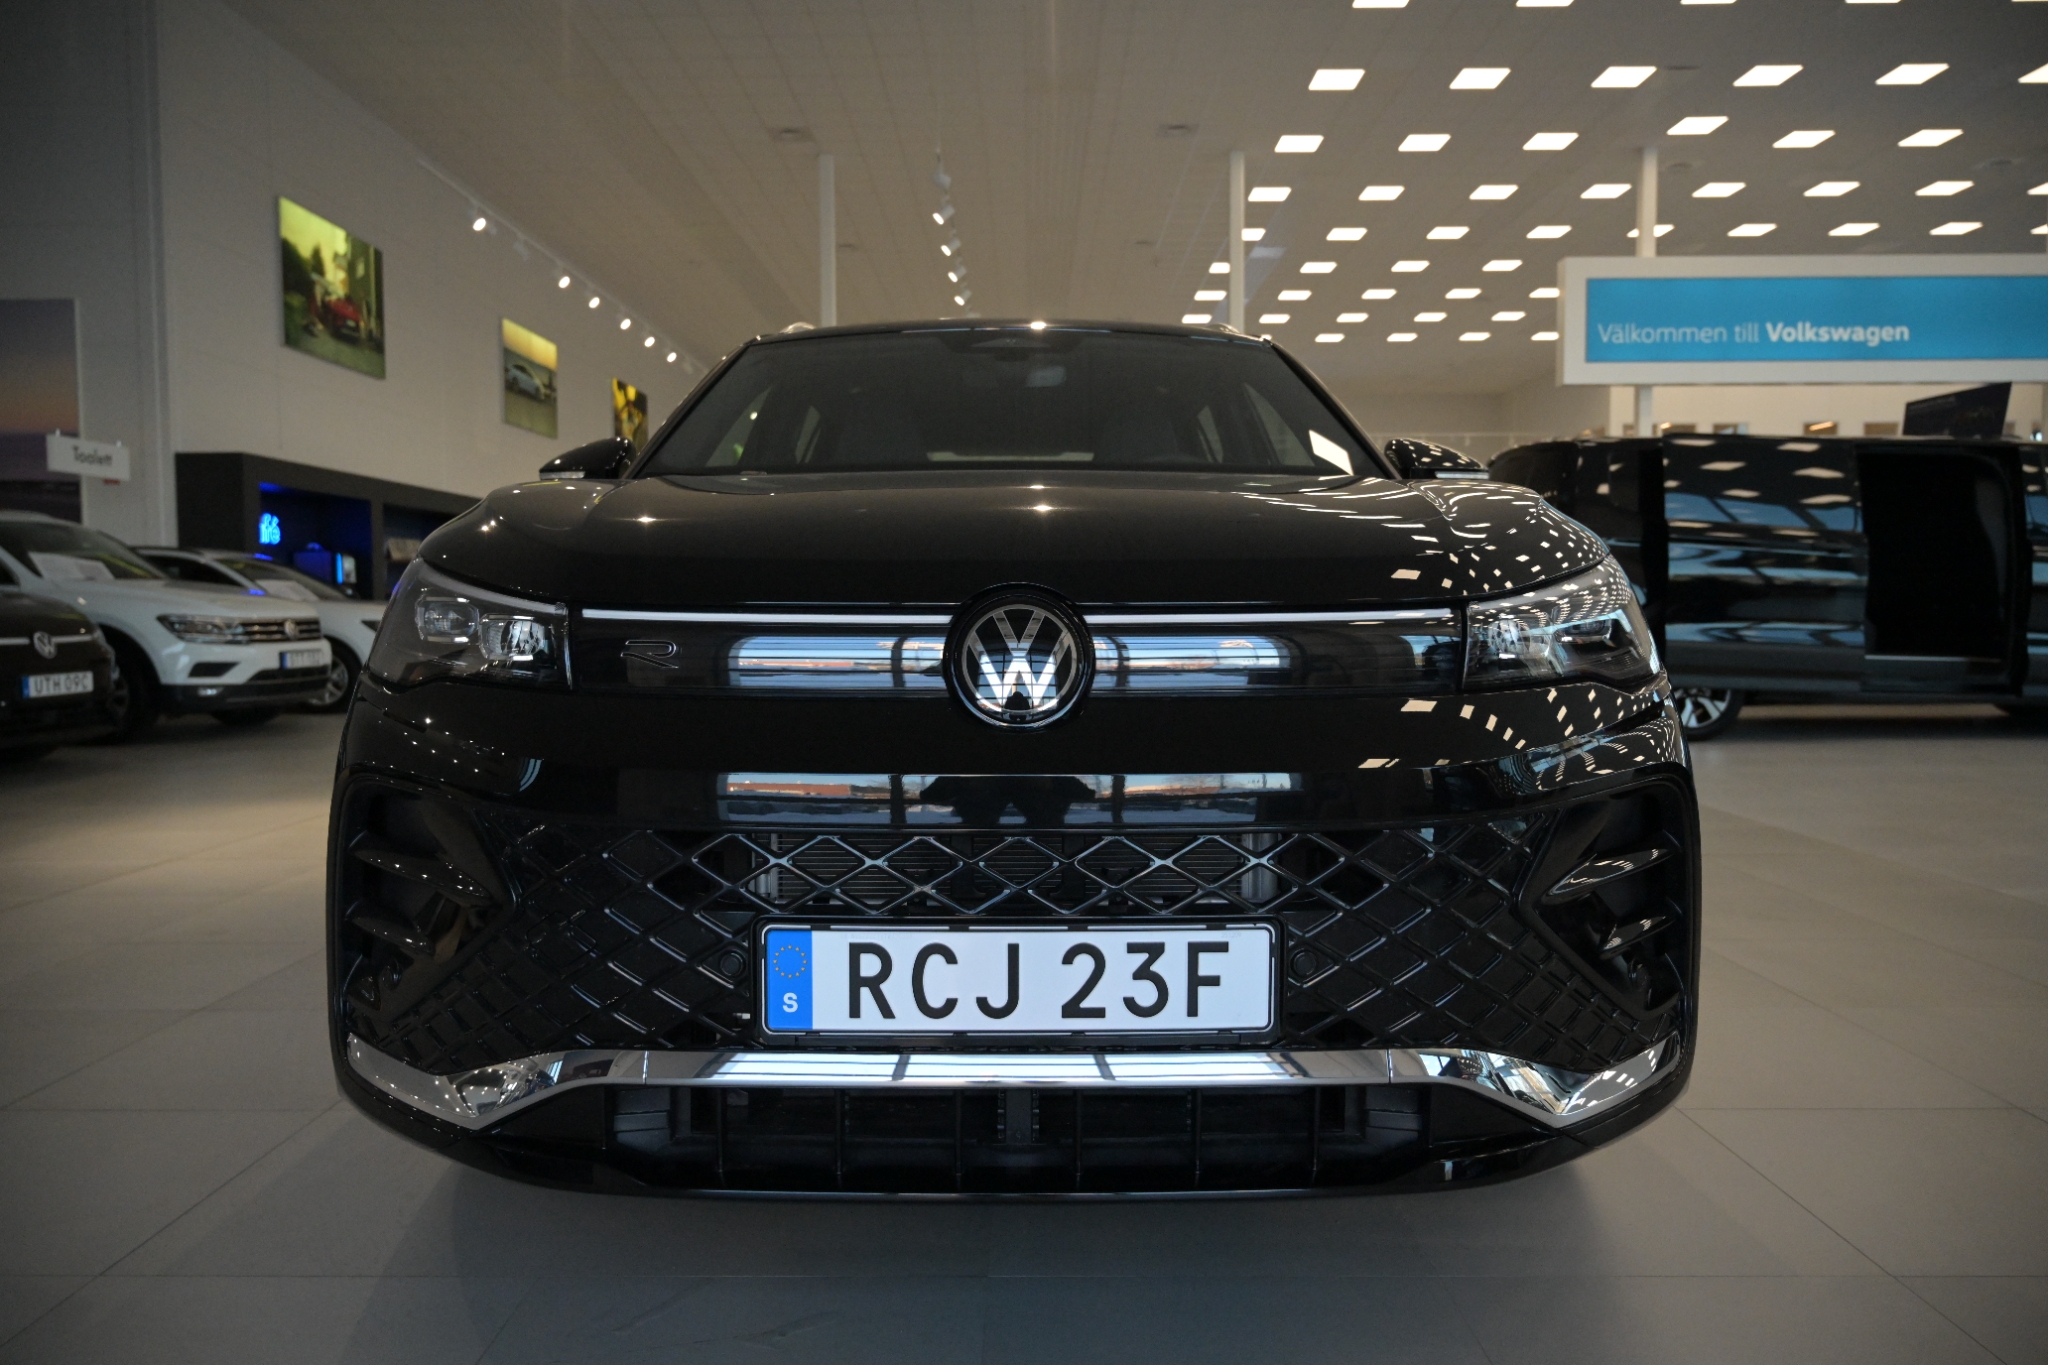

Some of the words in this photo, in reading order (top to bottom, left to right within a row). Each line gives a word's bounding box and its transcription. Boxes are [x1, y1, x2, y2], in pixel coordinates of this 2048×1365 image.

[1597, 322, 1727, 344] Välkommen
[1734, 322, 1760, 343] till
[1765, 322, 1910, 347] Volkswagen
[848, 941, 1020, 1020] RCJ
[1060, 940, 1229, 1019] 23F
[782, 992, 799, 1014] S
